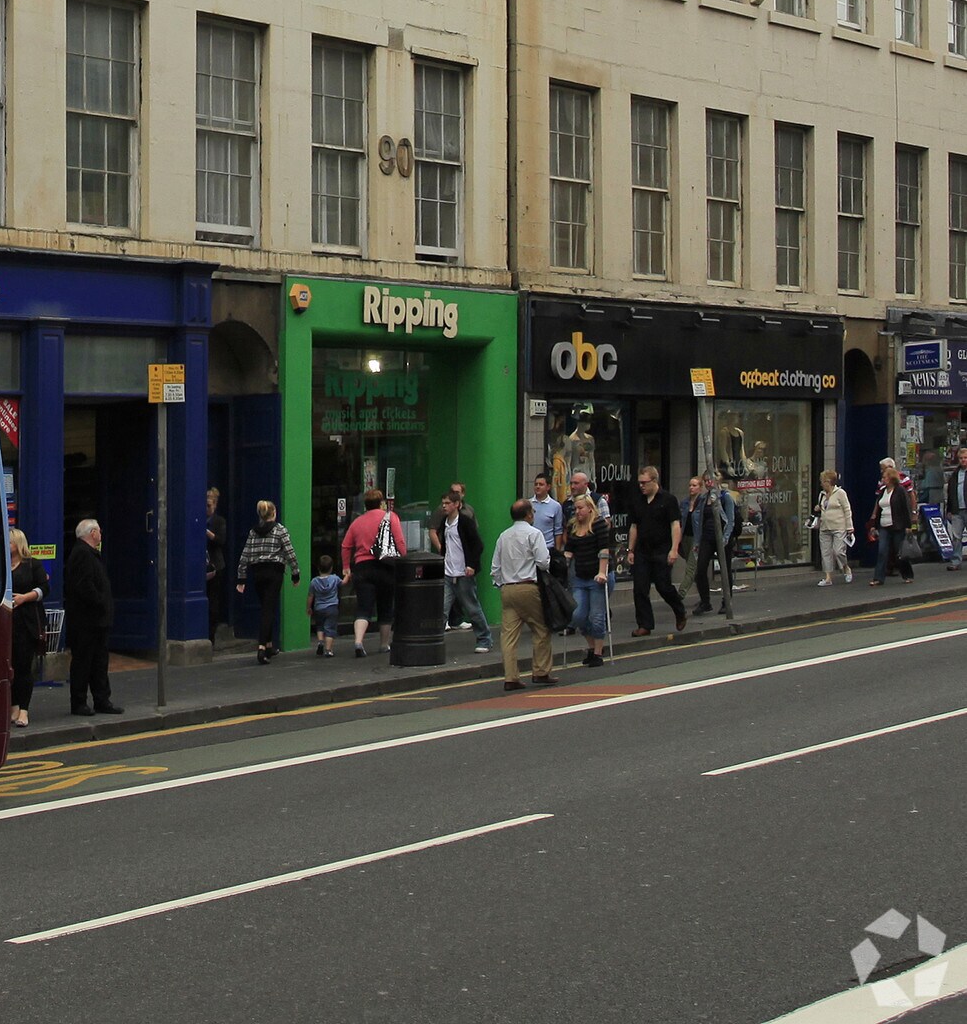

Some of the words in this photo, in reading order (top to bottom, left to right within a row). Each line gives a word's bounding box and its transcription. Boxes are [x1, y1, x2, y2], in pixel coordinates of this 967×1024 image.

[378, 135, 414, 178] 90
[363, 285, 458, 339] Ripping
[906, 358, 939, 366] SCOTSMAN
[822, 374, 836, 388] co
[3, 399, 18, 419] SALE
[601, 464, 632, 482] DOWN
